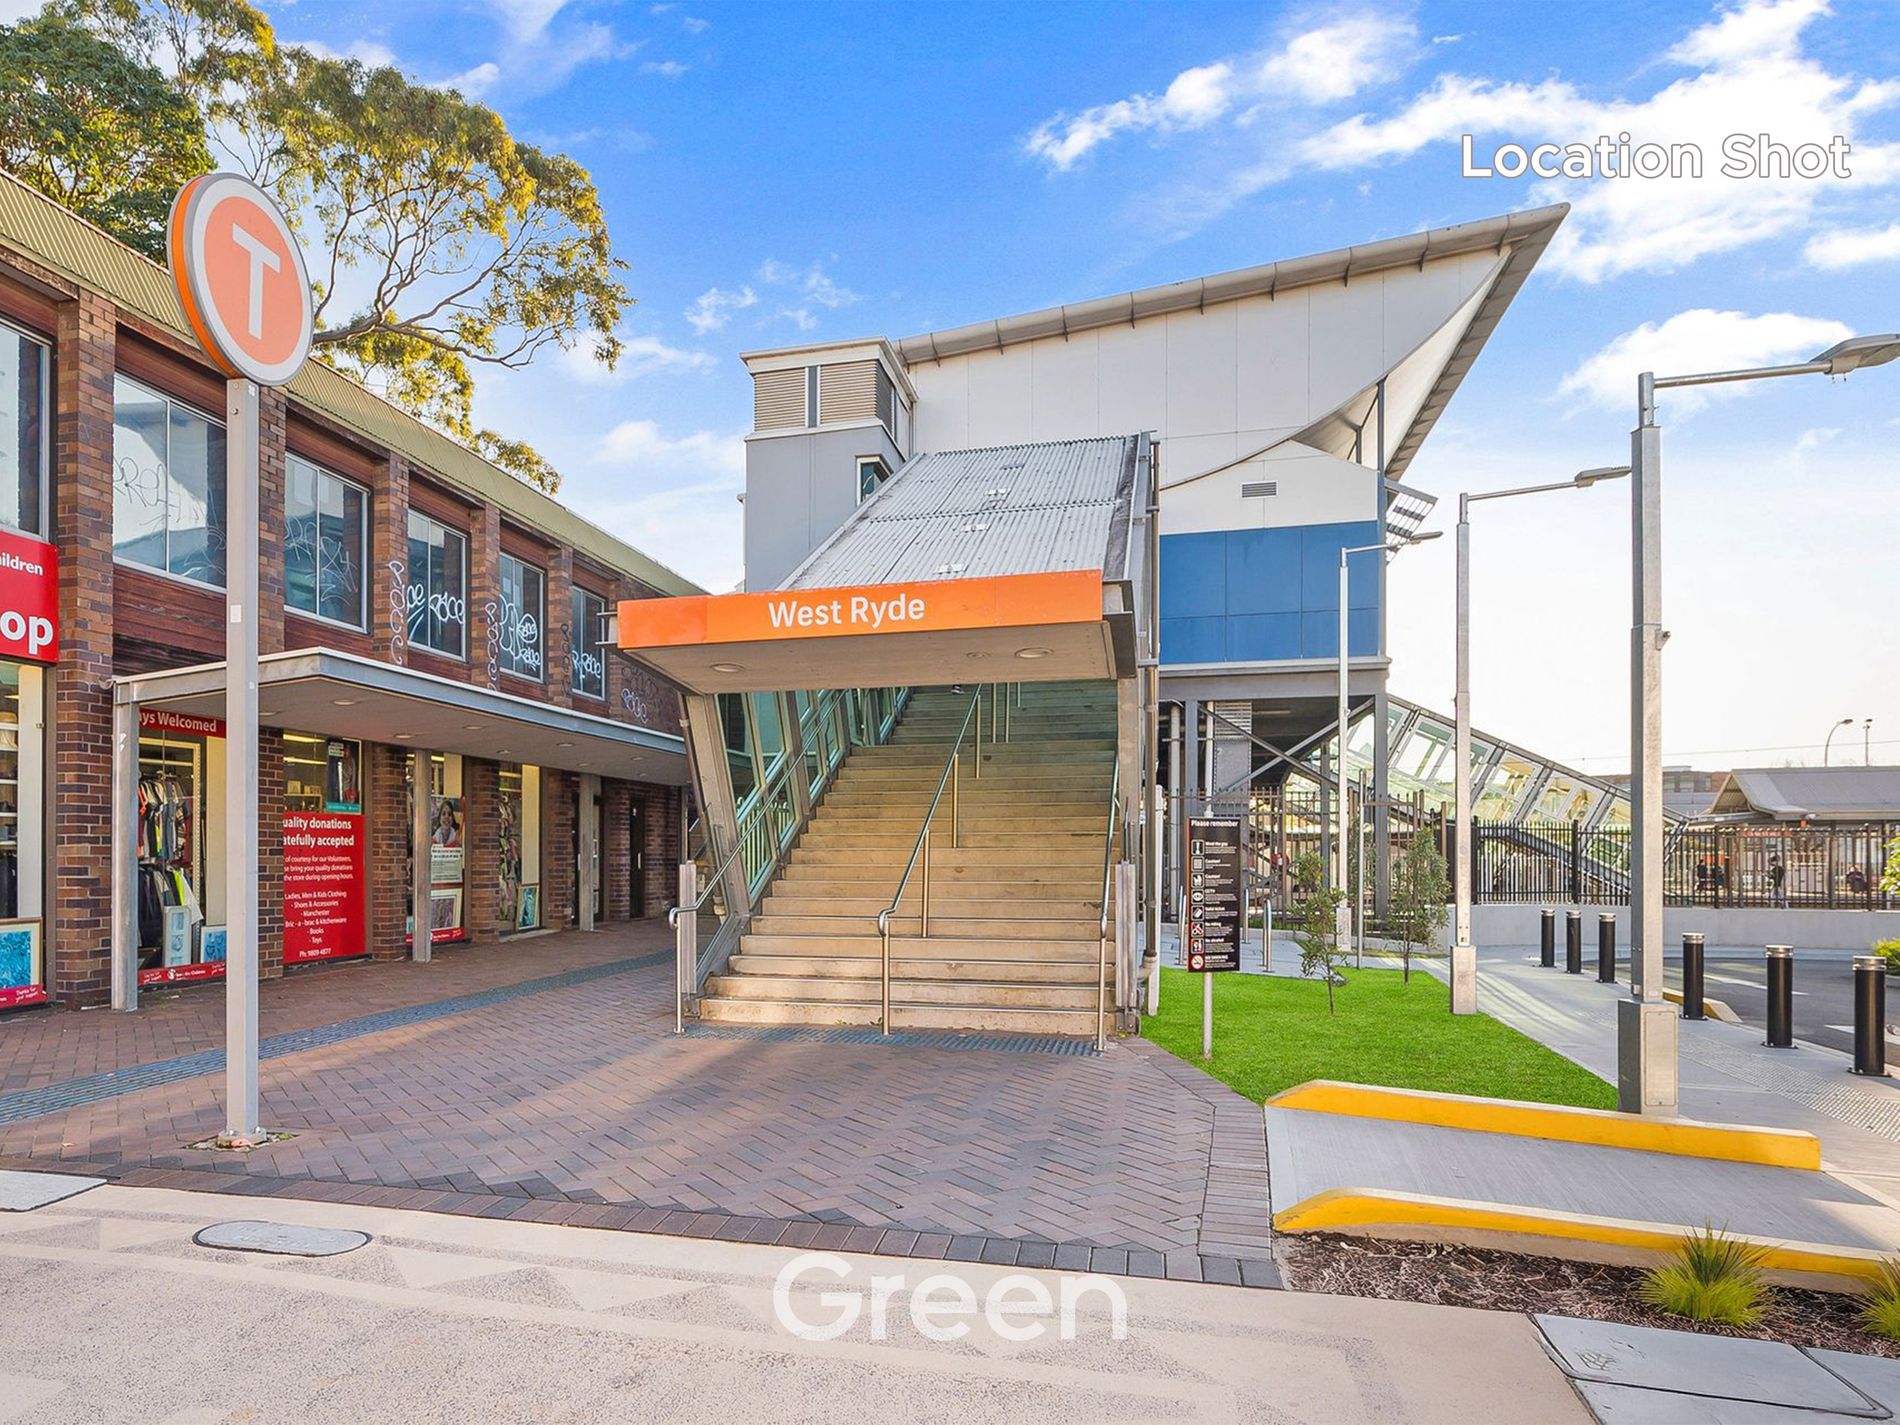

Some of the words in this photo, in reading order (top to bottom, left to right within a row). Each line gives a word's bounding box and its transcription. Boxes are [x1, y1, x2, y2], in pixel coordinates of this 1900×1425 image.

[232, 221, 281, 341] T
[0, 551, 44, 576] ildren
[768, 600, 843, 628] West
[850, 593, 926, 630] Ryde
[0, 610, 54, 655] op
[156, 711, 218, 733] Welcomed
[283, 816, 309, 831] uality
[309, 816, 353, 830] donations
[283, 833, 316, 848] atefully
[316, 835, 355, 848] accepted
